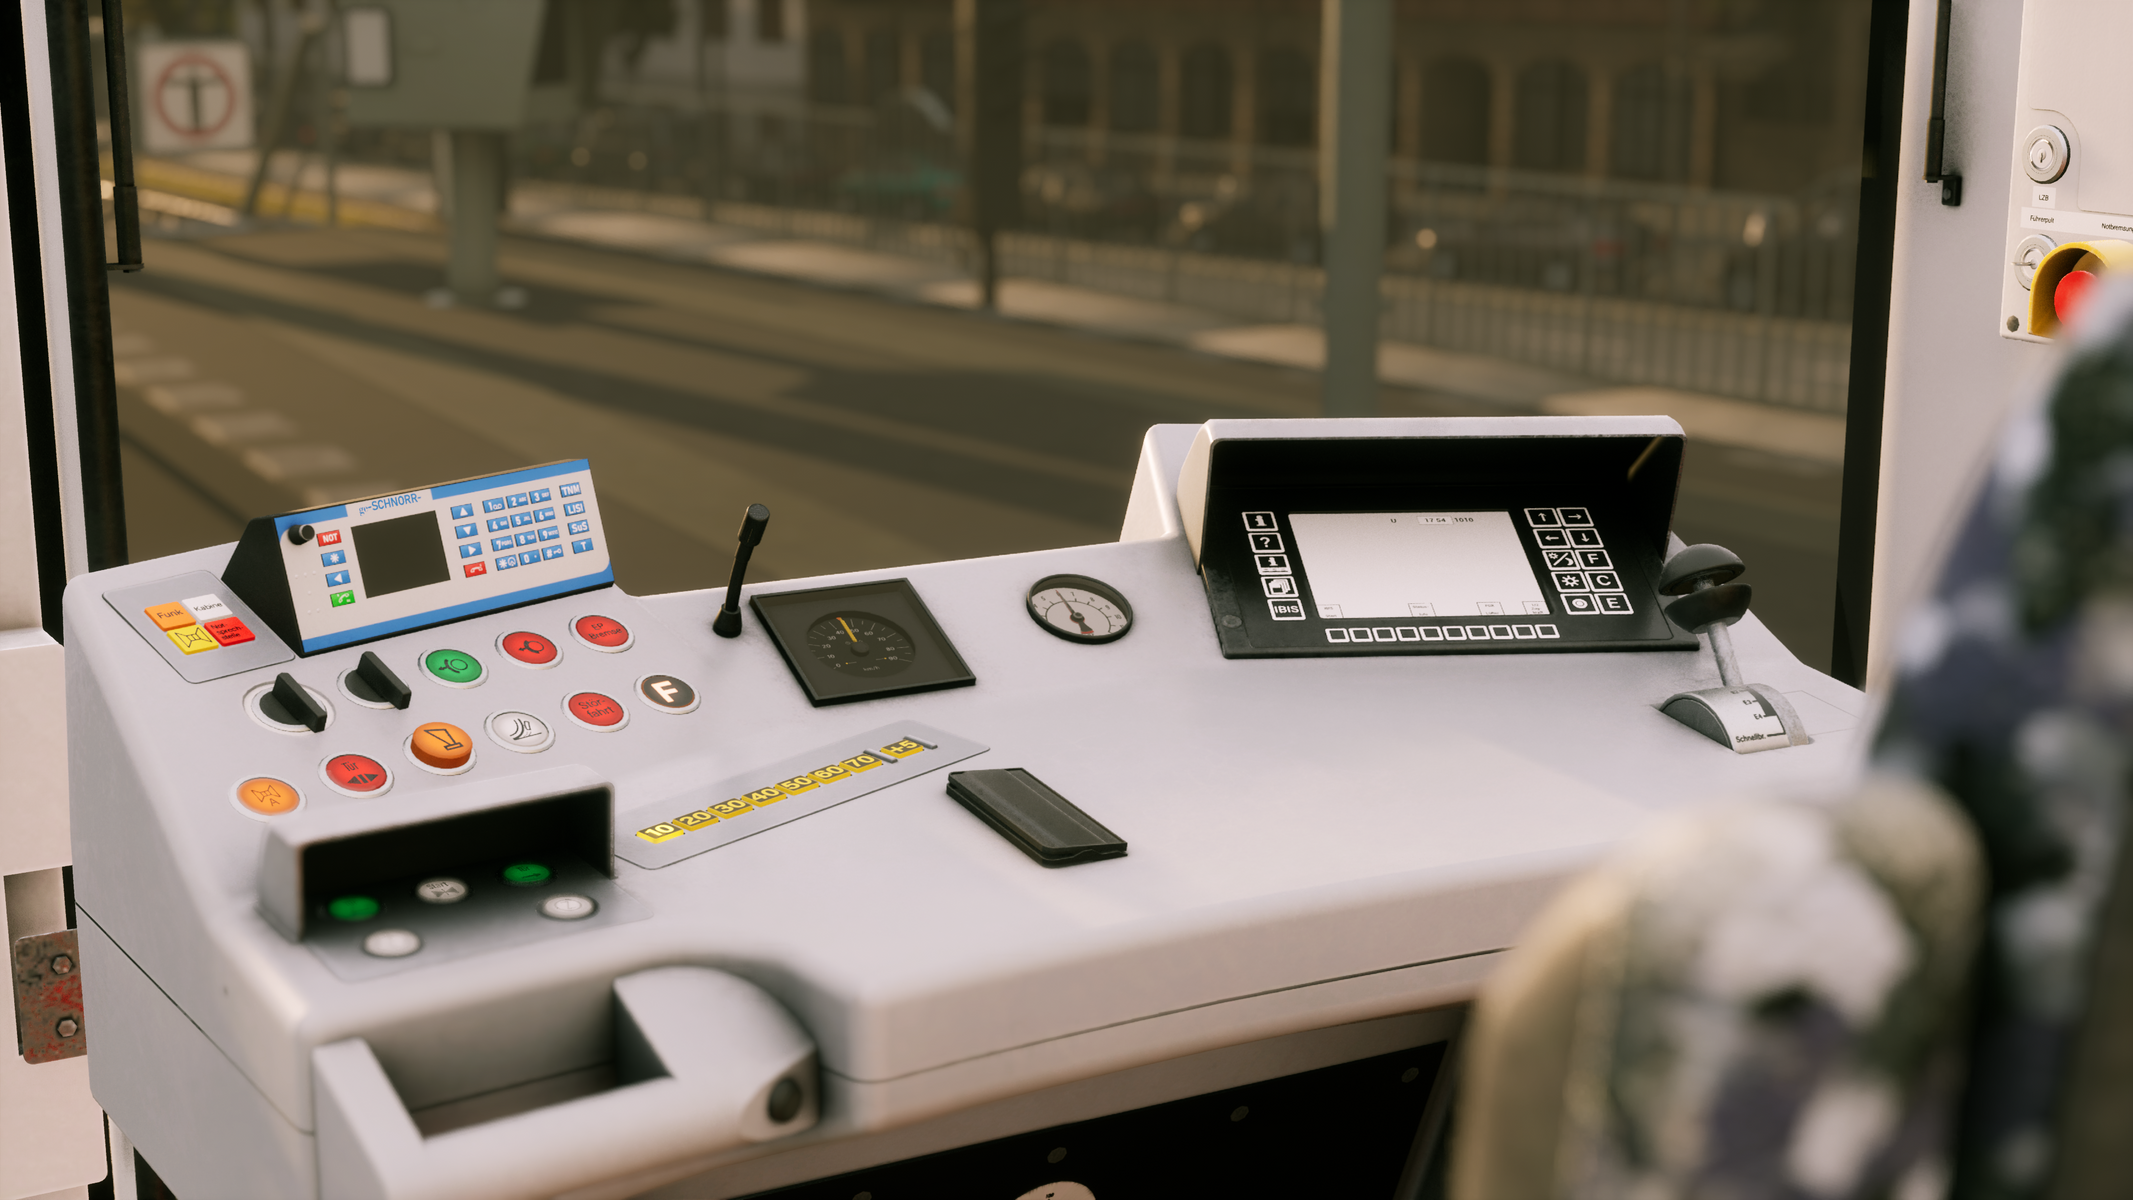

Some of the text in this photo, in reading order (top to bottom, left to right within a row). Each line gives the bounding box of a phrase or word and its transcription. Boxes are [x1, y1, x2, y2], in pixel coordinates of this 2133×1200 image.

[561, 484, 580, 496] TNM
[511, 497, 517, 506] 2
[534, 492, 540, 502] 3
[488, 502, 493, 510] 1
[567, 504, 583, 514] LISI
[515, 516, 521, 525] 5
[538, 511, 544, 520] 6
[492, 520, 498, 530] 4
[571, 522, 588, 533] SuS
[322, 533, 338, 543] NOT
[519, 535, 526, 544] 8
[542, 530, 548, 539] 9
[496, 540, 501, 549] 7
[581, 541, 586, 550] T
[524, 554, 529, 564] 0
[1587, 554, 1599, 564] F
[1596, 575, 1611, 586] C
[193, 602, 223, 612] Kabine
[1606, 598, 1620, 608] E
[156, 609, 184, 619] Funk
[591, 622, 604, 630] EP
[588, 628, 622, 640] Bremse
[650, 680, 679, 703] F
[578, 699, 605, 709] Stör-
[586, 706, 615, 718] fahrt
[341, 760, 359, 772] Tür
[644, 740, 918, 836] 10 20 30 40 50 60 70 +5
[269, 798, 280, 806] A
[426, 881, 449, 890] Start
